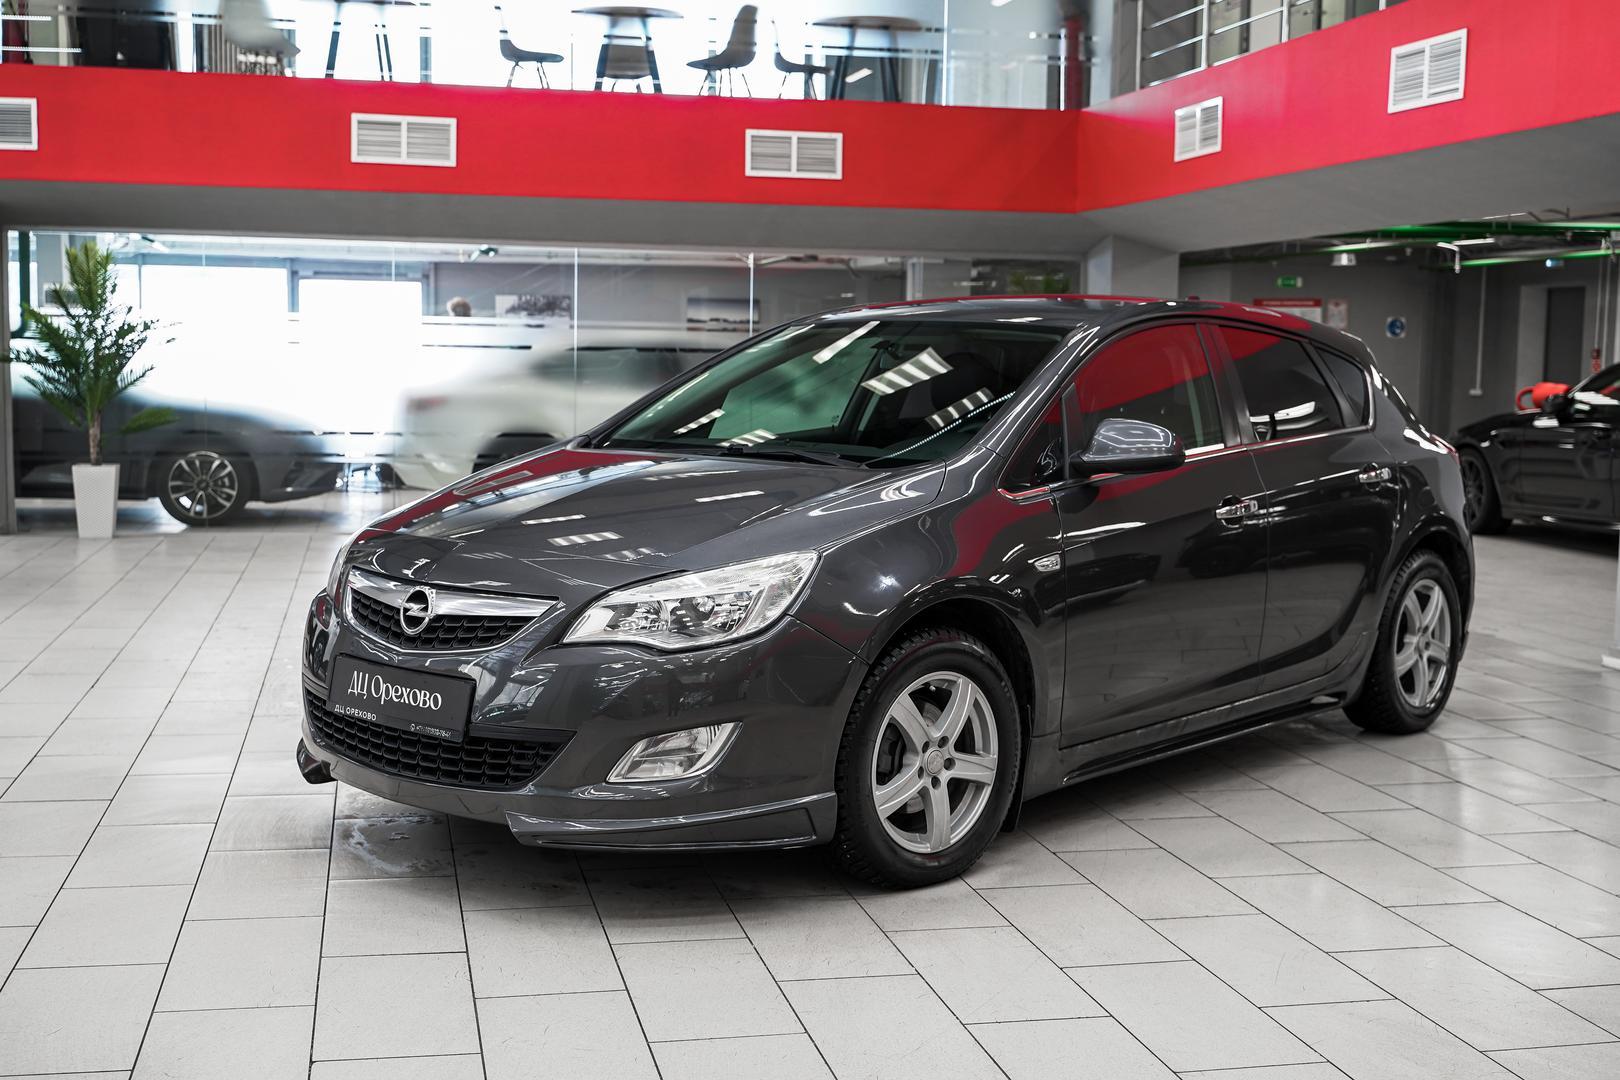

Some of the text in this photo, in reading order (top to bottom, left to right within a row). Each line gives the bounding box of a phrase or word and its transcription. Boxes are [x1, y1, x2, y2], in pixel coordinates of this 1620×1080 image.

[348, 671, 442, 711] ДЦ Орехово
[334, 704, 377, 721] ДЦ ОРЕХОВО
